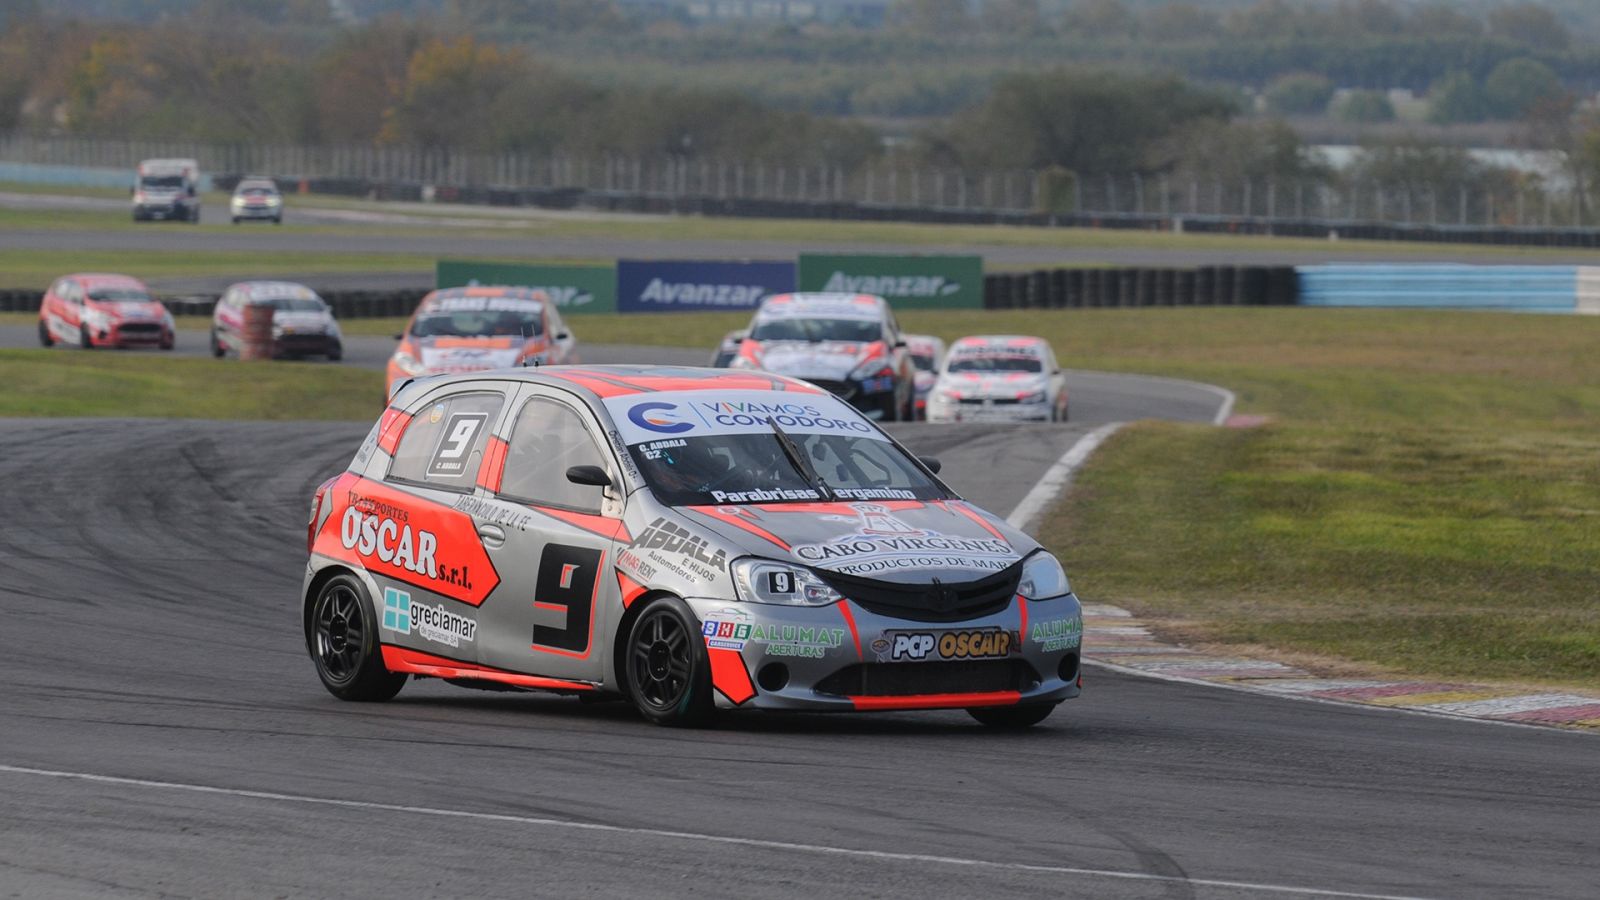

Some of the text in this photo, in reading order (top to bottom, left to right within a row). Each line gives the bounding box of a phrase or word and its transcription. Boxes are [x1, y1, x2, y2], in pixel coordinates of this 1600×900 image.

[640, 278, 764, 305] Avanzar
[822, 271, 944, 297] Avanzar
[702, 402, 822, 417] VIVAMOS
[439, 419, 481, 458] 9
[645, 450, 662, 460] C2
[348, 490, 409, 522] TRANSPORTES
[711, 487, 820, 503] Parabrisas
[341, 505, 438, 580] OSCAR
[797, 540, 877, 561] CABO
[438, 563, 472, 590] s.r.l.
[647, 551, 697, 583] Automotores
[681, 558, 716, 582] E HIJOS
[836, 556, 1008, 575] PRODUCTOS DE MAR
[775, 572, 789, 592] 9
[532, 543, 605, 657] 9
[410, 604, 475, 639] greciamar
[751, 623, 844, 646] ALUMAT
[765, 642, 826, 659] ABERTURAS
[892, 630, 1011, 660] PCP OSCAR
